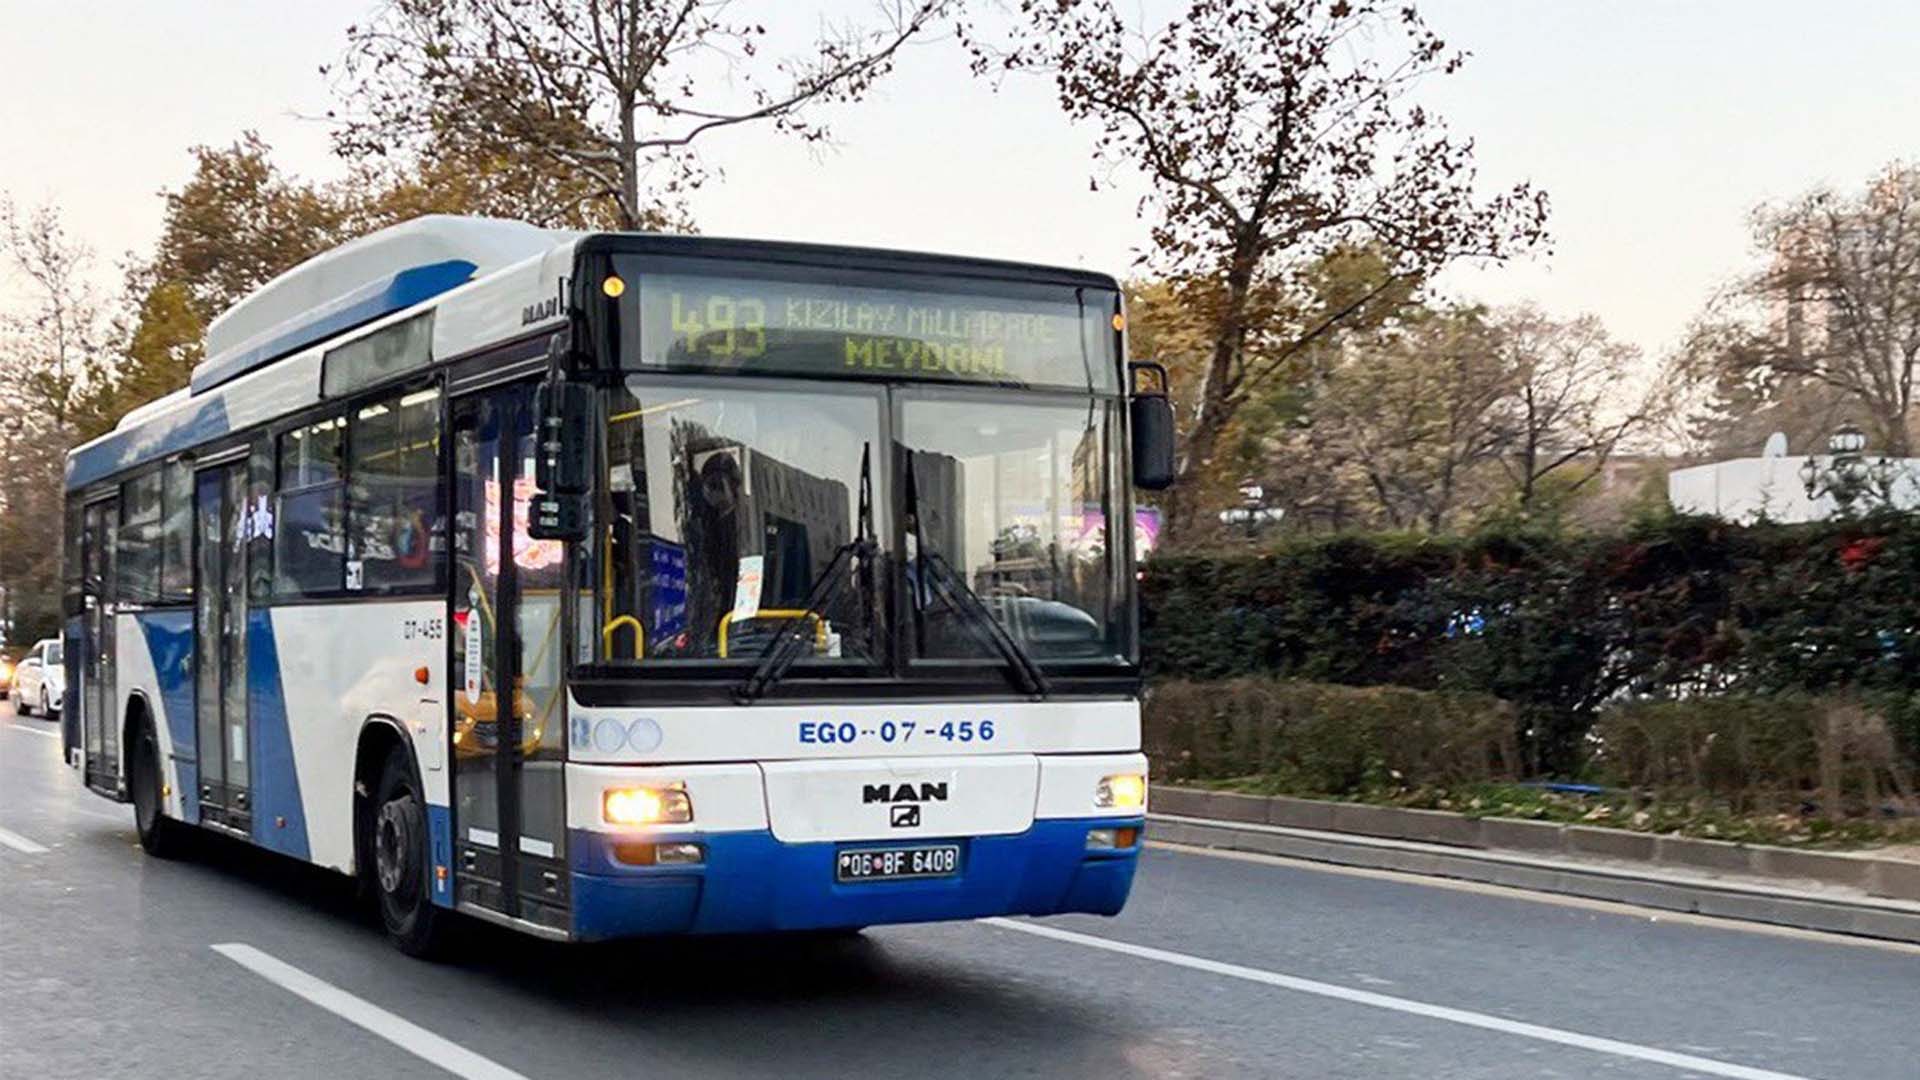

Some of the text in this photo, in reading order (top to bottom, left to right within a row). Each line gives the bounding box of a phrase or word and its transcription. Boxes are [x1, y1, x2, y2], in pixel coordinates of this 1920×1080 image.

[672, 293, 766, 357] 493
[786, 298, 896, 332] KIZILAY
[846, 336, 1005, 376] MEYDANI
[863, 782, 948, 803] MAN
[851, 849, 954, 876] 06 BF 6408
